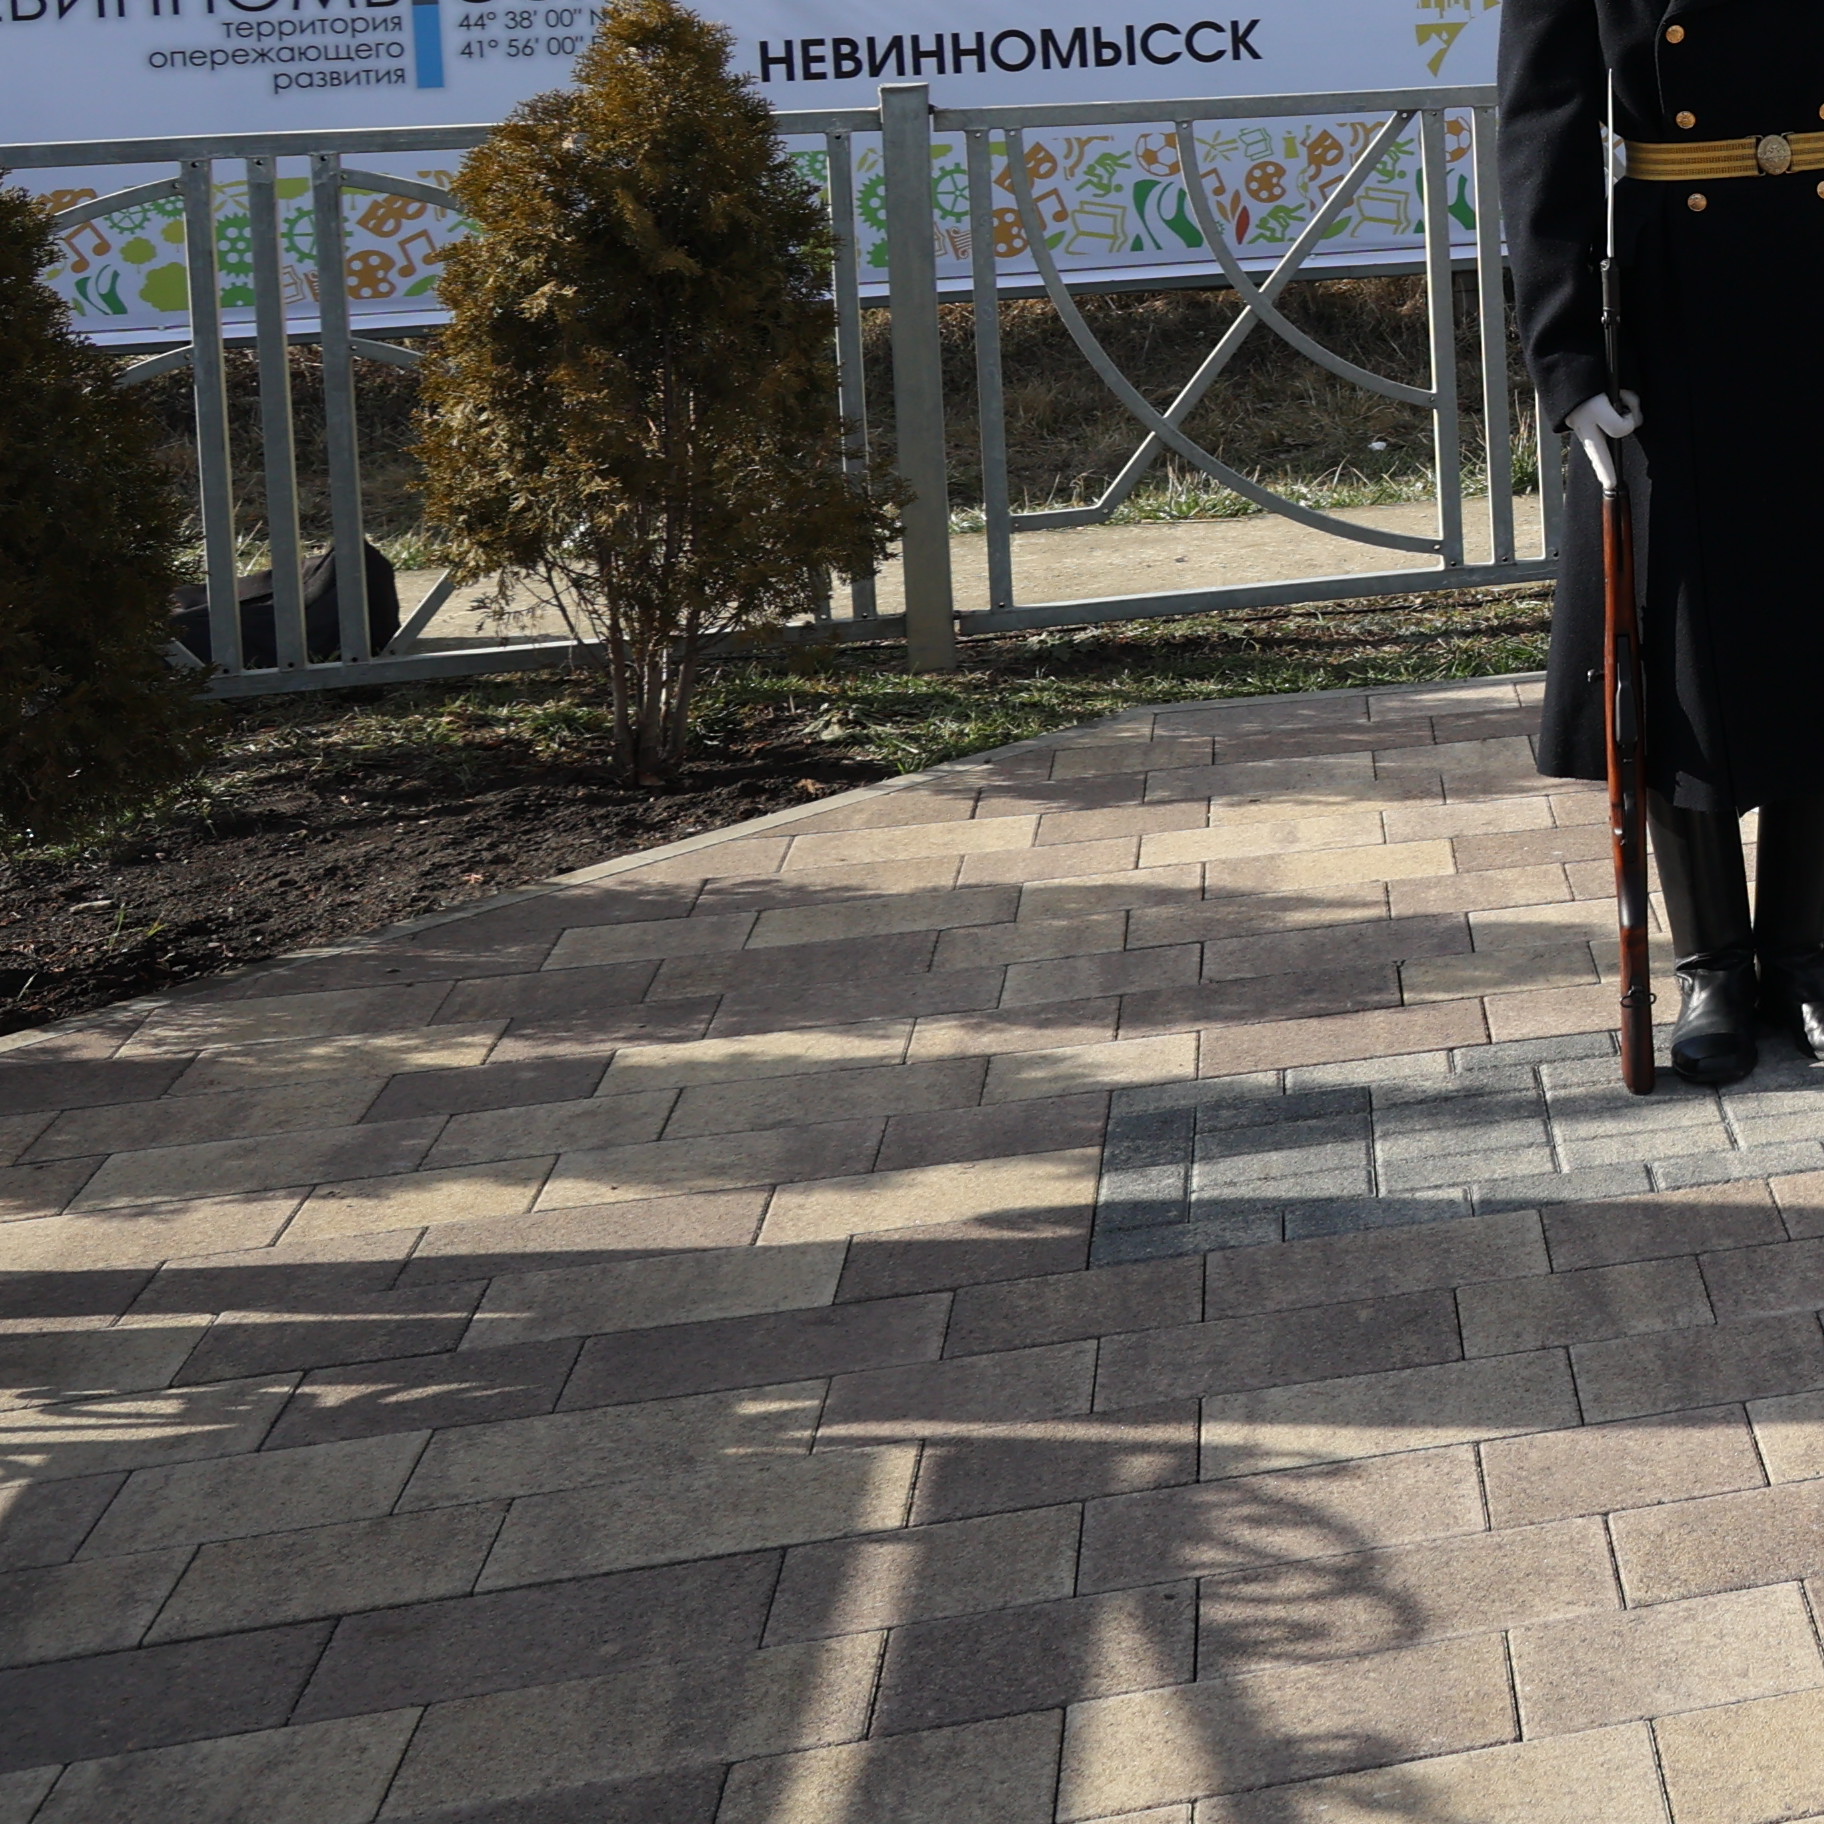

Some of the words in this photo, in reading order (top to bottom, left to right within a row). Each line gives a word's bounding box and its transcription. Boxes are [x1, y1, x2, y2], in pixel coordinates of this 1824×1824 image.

[222, 15, 403, 43] территория
[458, 10, 497, 31] 44°
[148, 41, 406, 71] опережающего
[460, 39, 499, 59] 41°
[757, 18, 1264, 84] НЕВИННОМЫССК
[273, 67, 406, 95] развития
